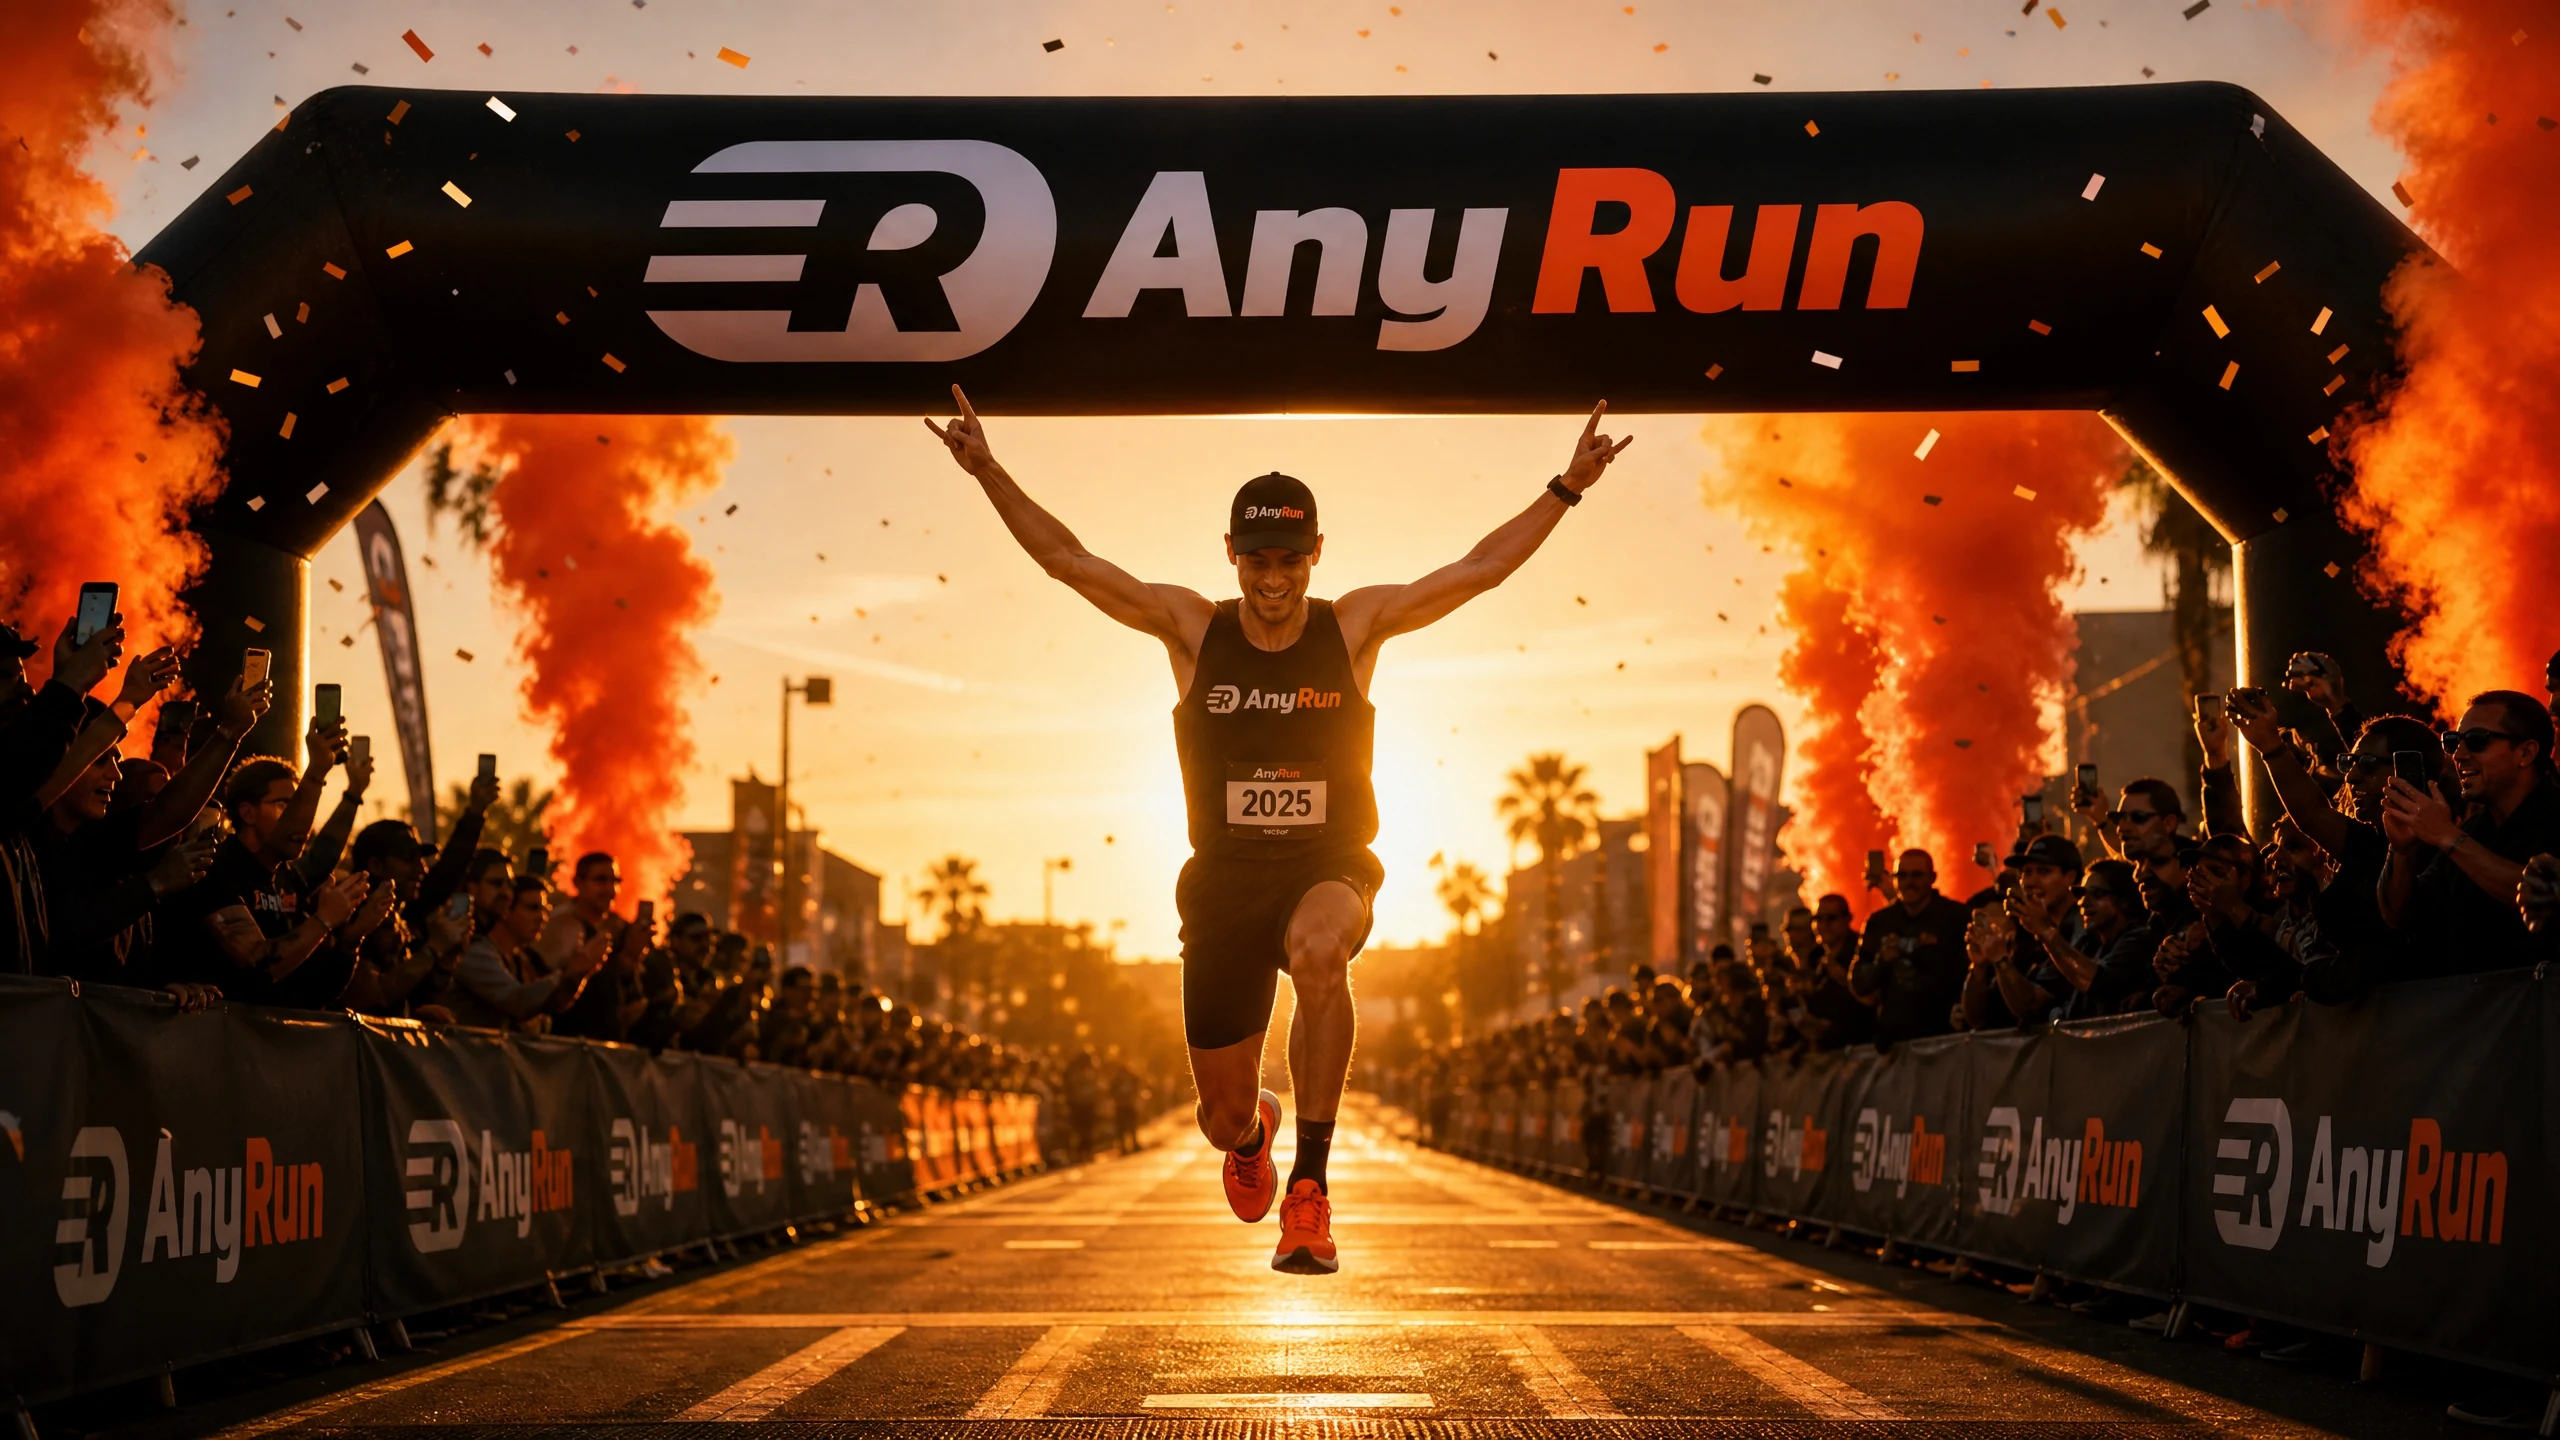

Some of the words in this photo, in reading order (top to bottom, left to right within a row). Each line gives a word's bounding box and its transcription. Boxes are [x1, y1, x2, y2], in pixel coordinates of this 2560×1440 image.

[1258, 506, 1304, 520] AnyRun
[1243, 687, 1341, 714] AnyRun
[1241, 789, 1311, 817] 2025
[1253, 768, 1301, 780] AnyRun
[477, 1129, 573, 1239] AnyRun
[2022, 1116, 2143, 1225] AnyRun
[2300, 1115, 2508, 1269] AnyRun
[141, 1136, 324, 1283] AnyRun
